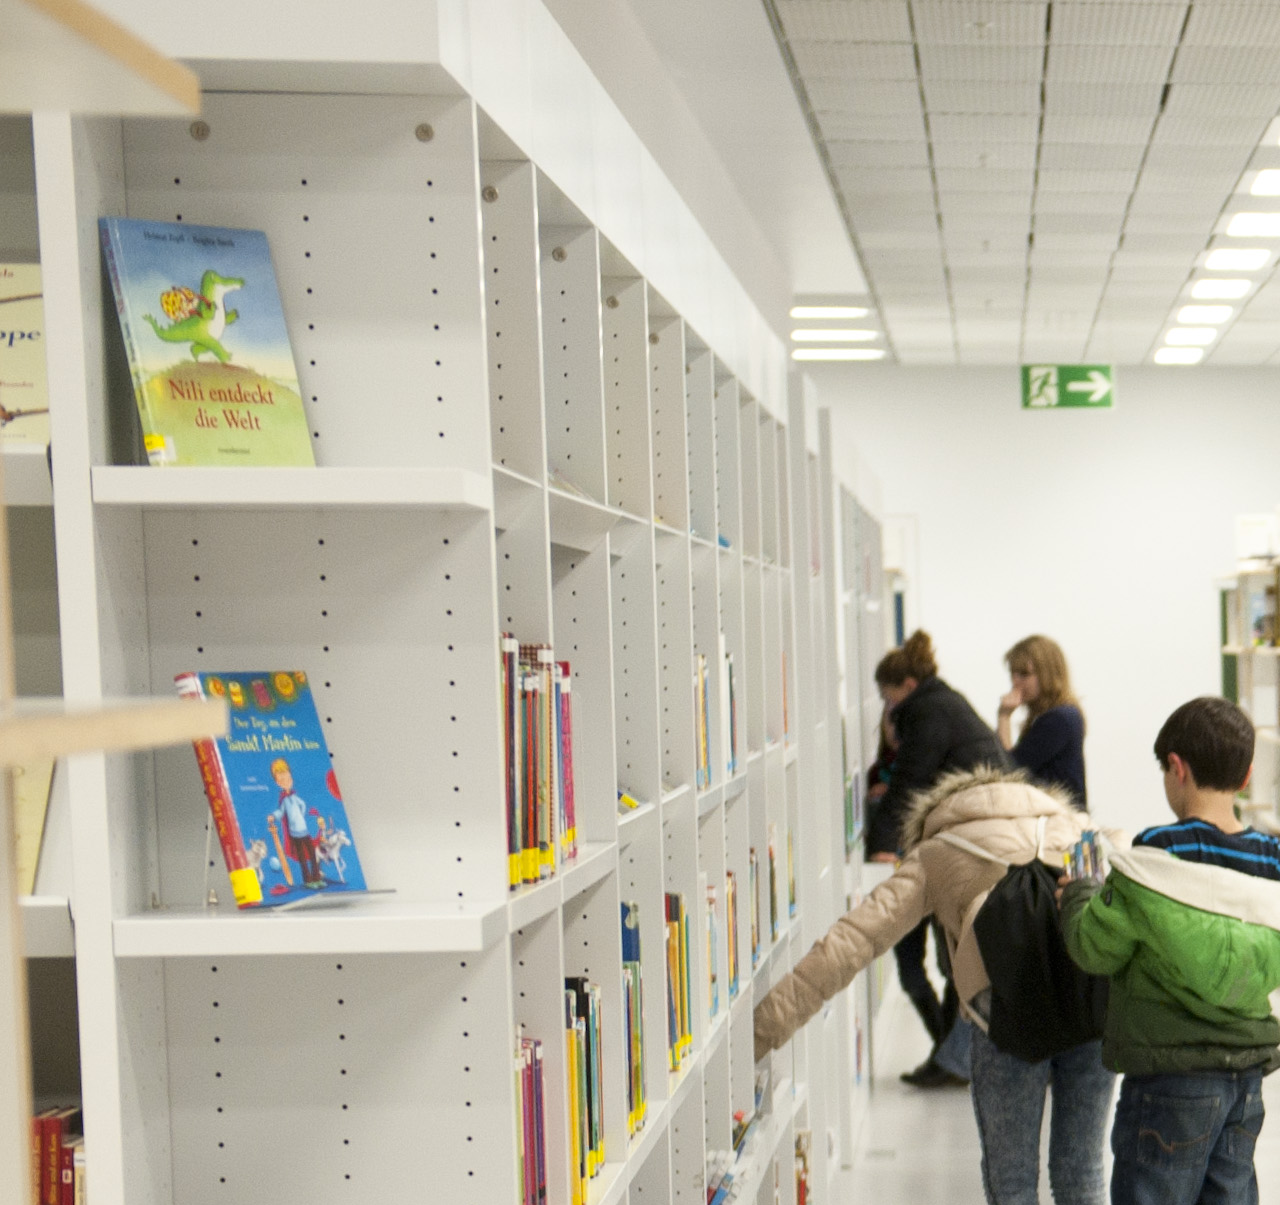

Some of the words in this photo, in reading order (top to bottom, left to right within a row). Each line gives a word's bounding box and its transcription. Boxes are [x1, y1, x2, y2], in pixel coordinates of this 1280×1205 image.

[169, 379, 205, 401] Nili
[209, 383, 275, 405] entdeckt
[195, 407, 218, 428] die
[222, 409, 261, 430] Welt
[262, 734, 303, 752] Martin
